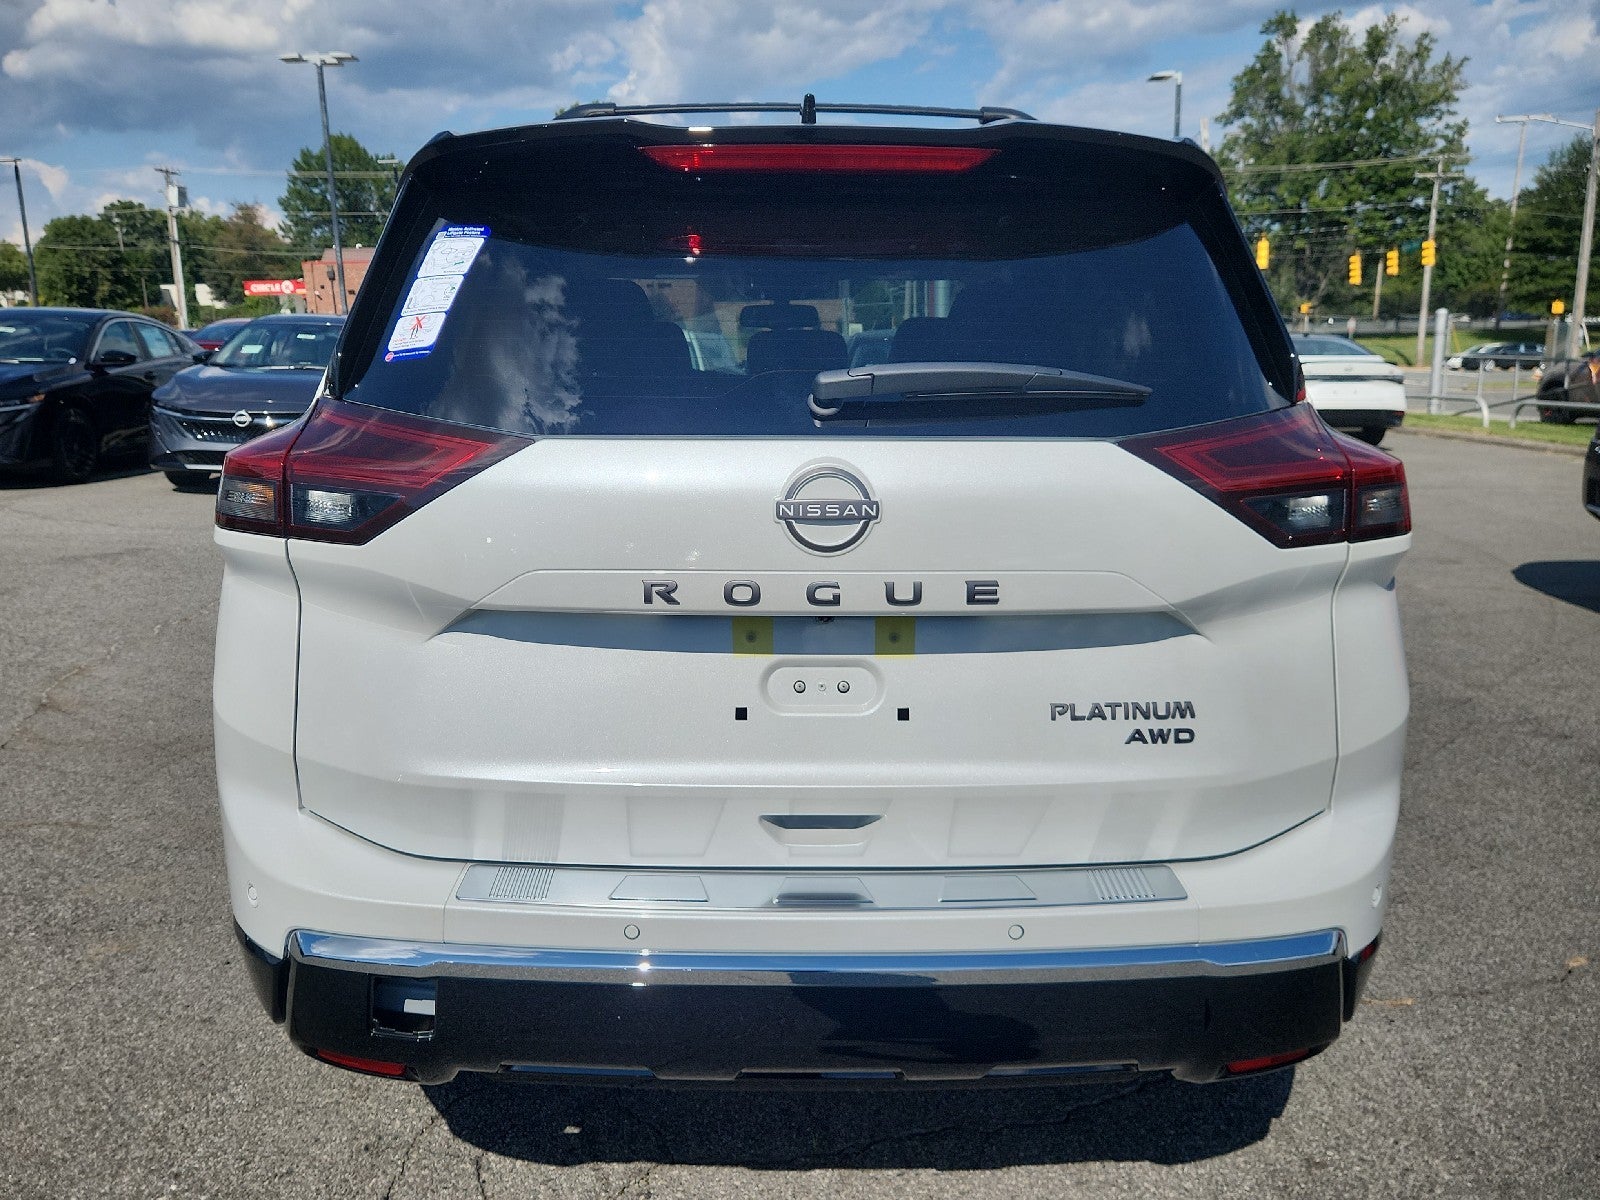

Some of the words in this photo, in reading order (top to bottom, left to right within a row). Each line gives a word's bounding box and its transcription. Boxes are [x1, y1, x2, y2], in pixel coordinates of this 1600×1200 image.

[250, 283, 281, 293] CIRCLE
[779, 504, 877, 517] NISSAN
[642, 579, 1000, 607] ROGUE
[1050, 701, 1196, 722] PLATINUM
[1125, 727, 1196, 745] AWD
